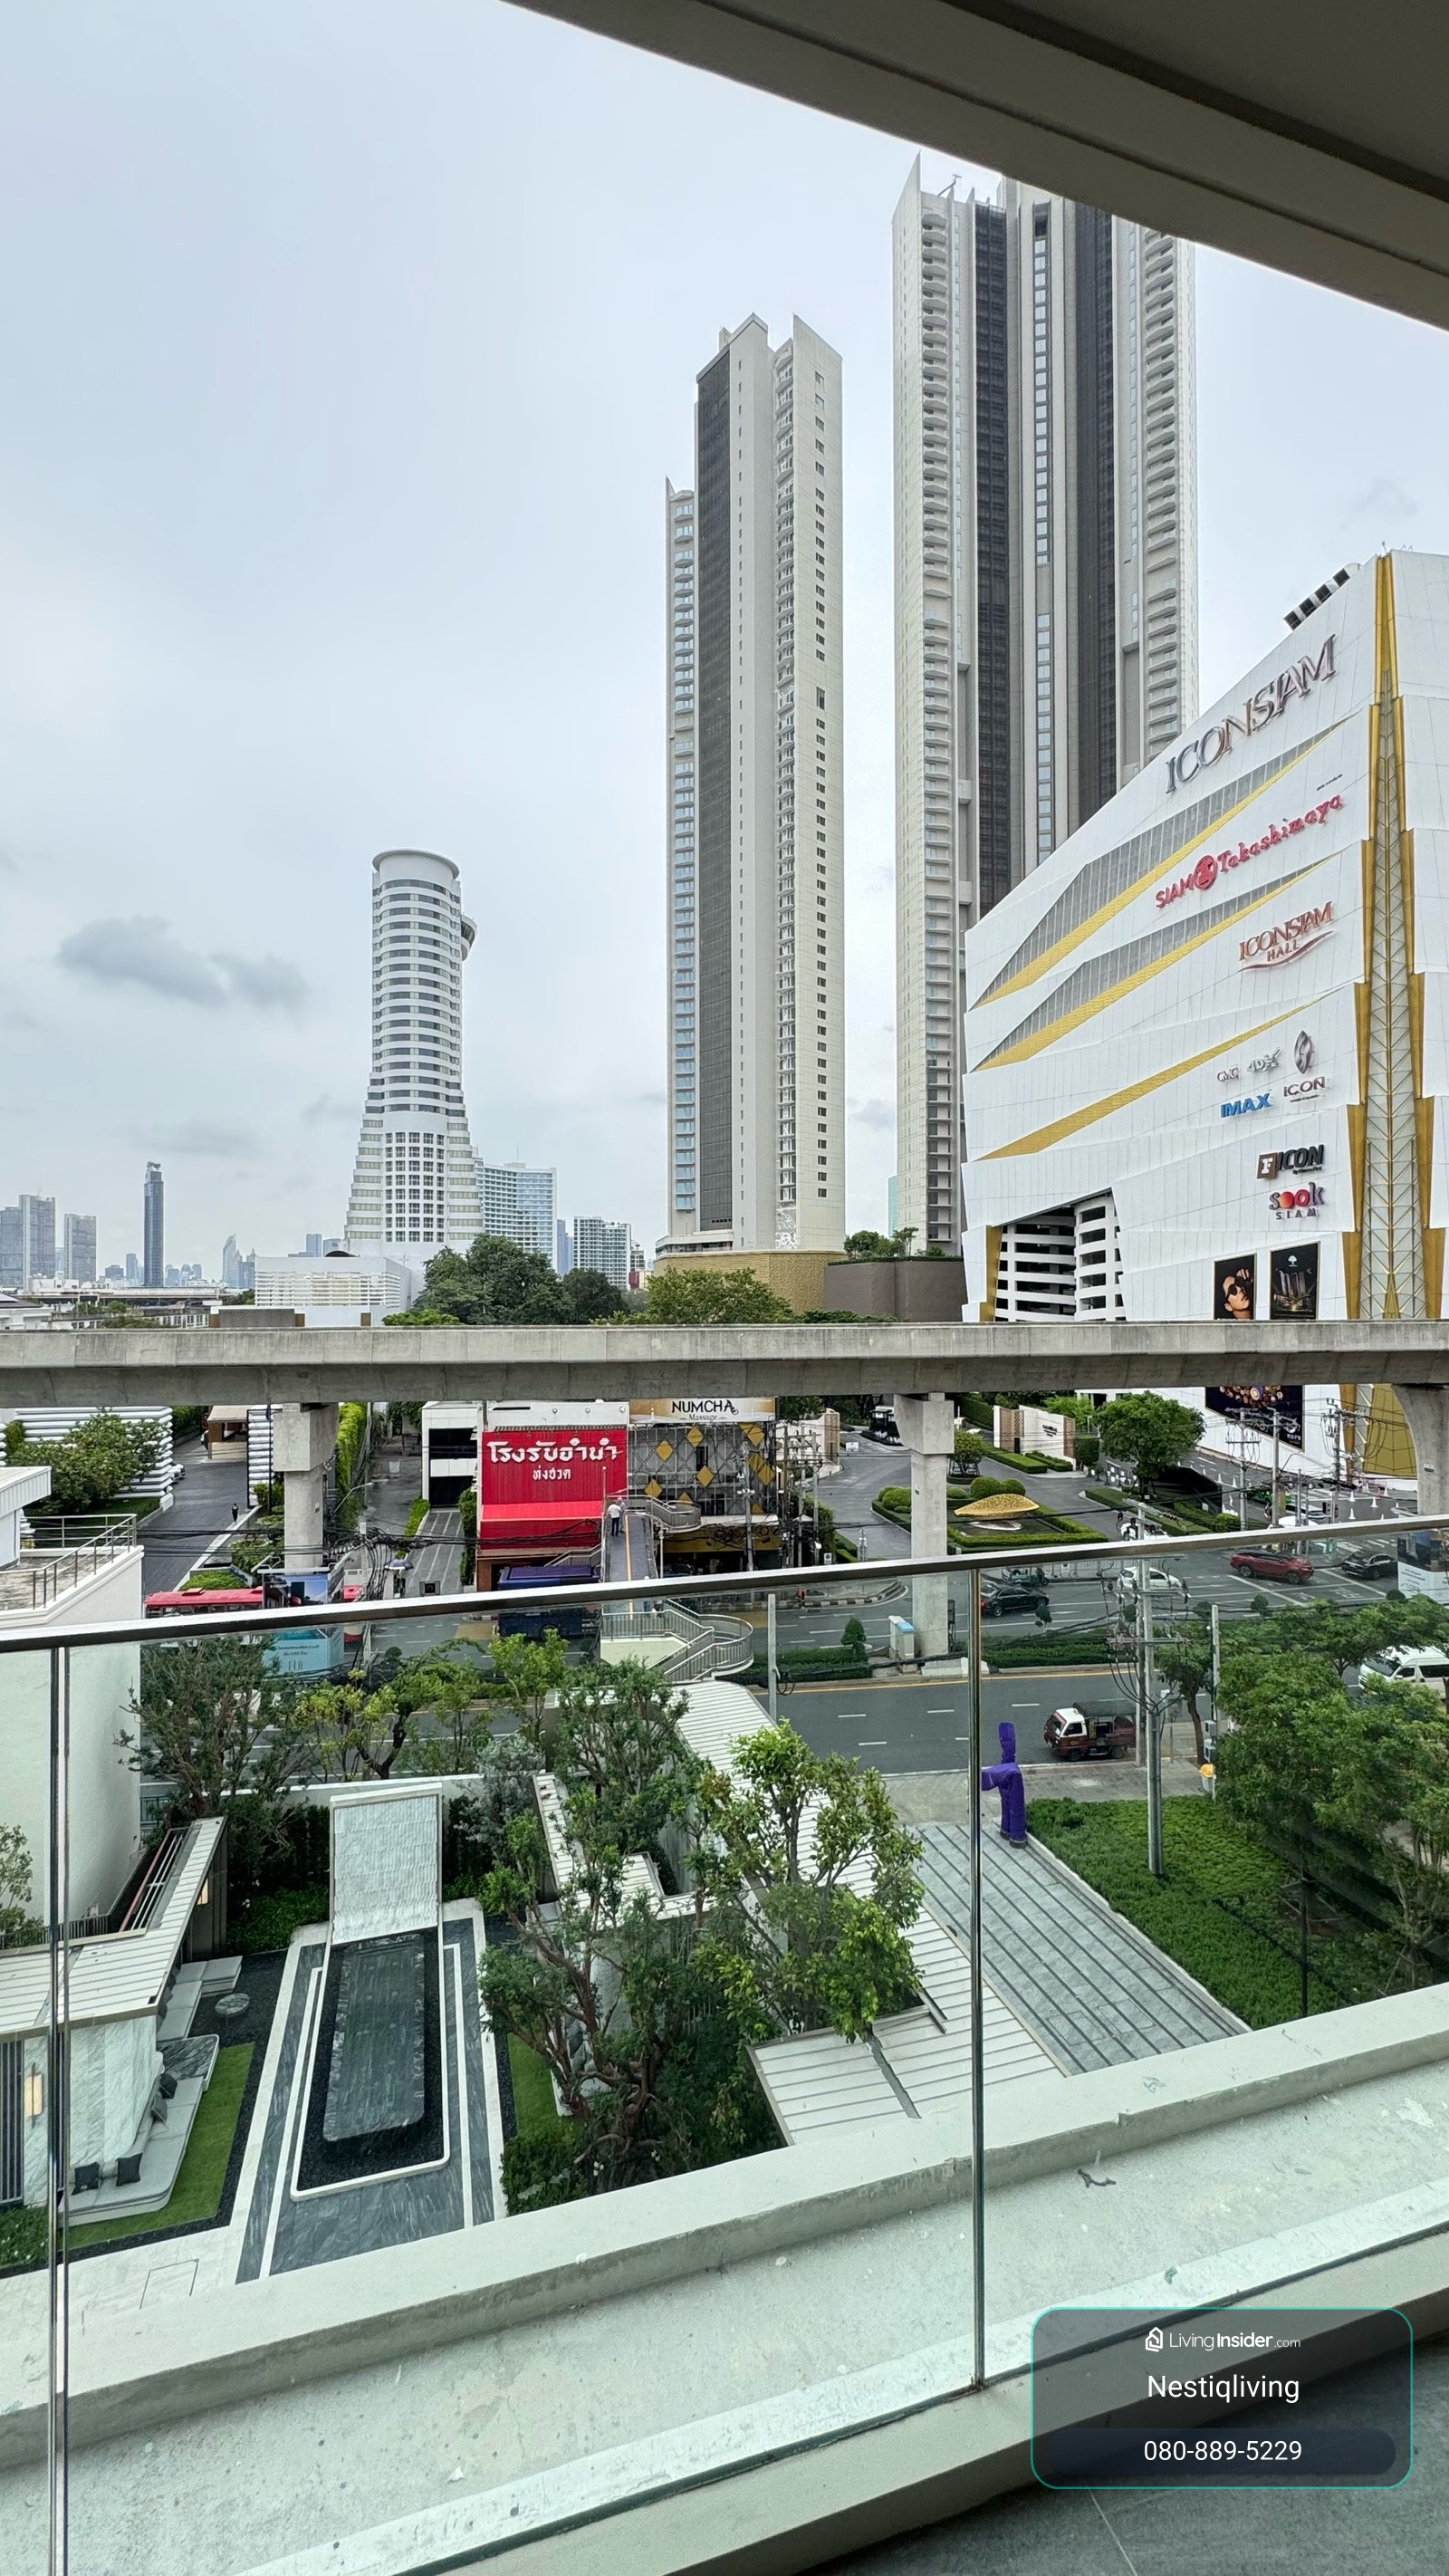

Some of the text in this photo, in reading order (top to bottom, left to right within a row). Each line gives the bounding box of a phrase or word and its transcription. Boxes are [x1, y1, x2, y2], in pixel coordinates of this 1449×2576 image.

[1166, 634, 1336, 793] ICONSIAM
[1156, 794, 1344, 908] SIAM Takashimaya
[1239, 900, 1333, 961] ICONSIAM
[1267, 939, 1300, 962] HALL
[1283, 1076, 1325, 1097] ICON
[1221, 1092, 1271, 1118] IMAX
[1276, 1144, 1325, 1170] ICON
[1276, 1207, 1317, 1220] SIAM
[671, 1399, 739, 1415] NUMCHA
[688, 1413, 717, 1423] Massage
